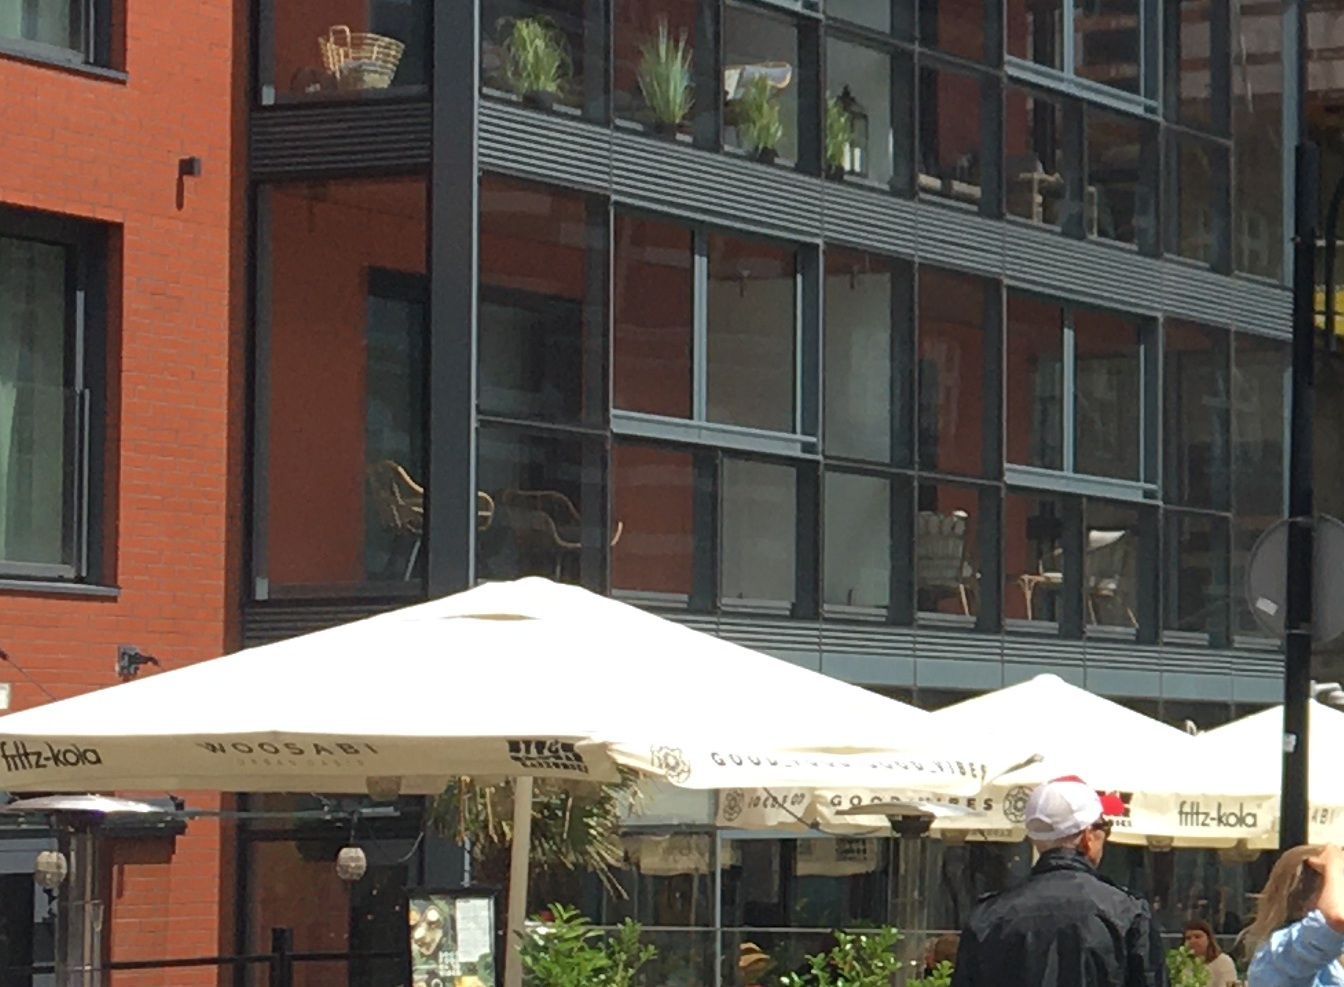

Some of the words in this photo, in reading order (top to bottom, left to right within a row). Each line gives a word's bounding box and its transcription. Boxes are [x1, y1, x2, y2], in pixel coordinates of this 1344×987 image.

[0, 741, 103, 772] fritz-kola
[196, 741, 379, 756] WOOSABI
[1178, 800, 1257, 828] fritz-kola
